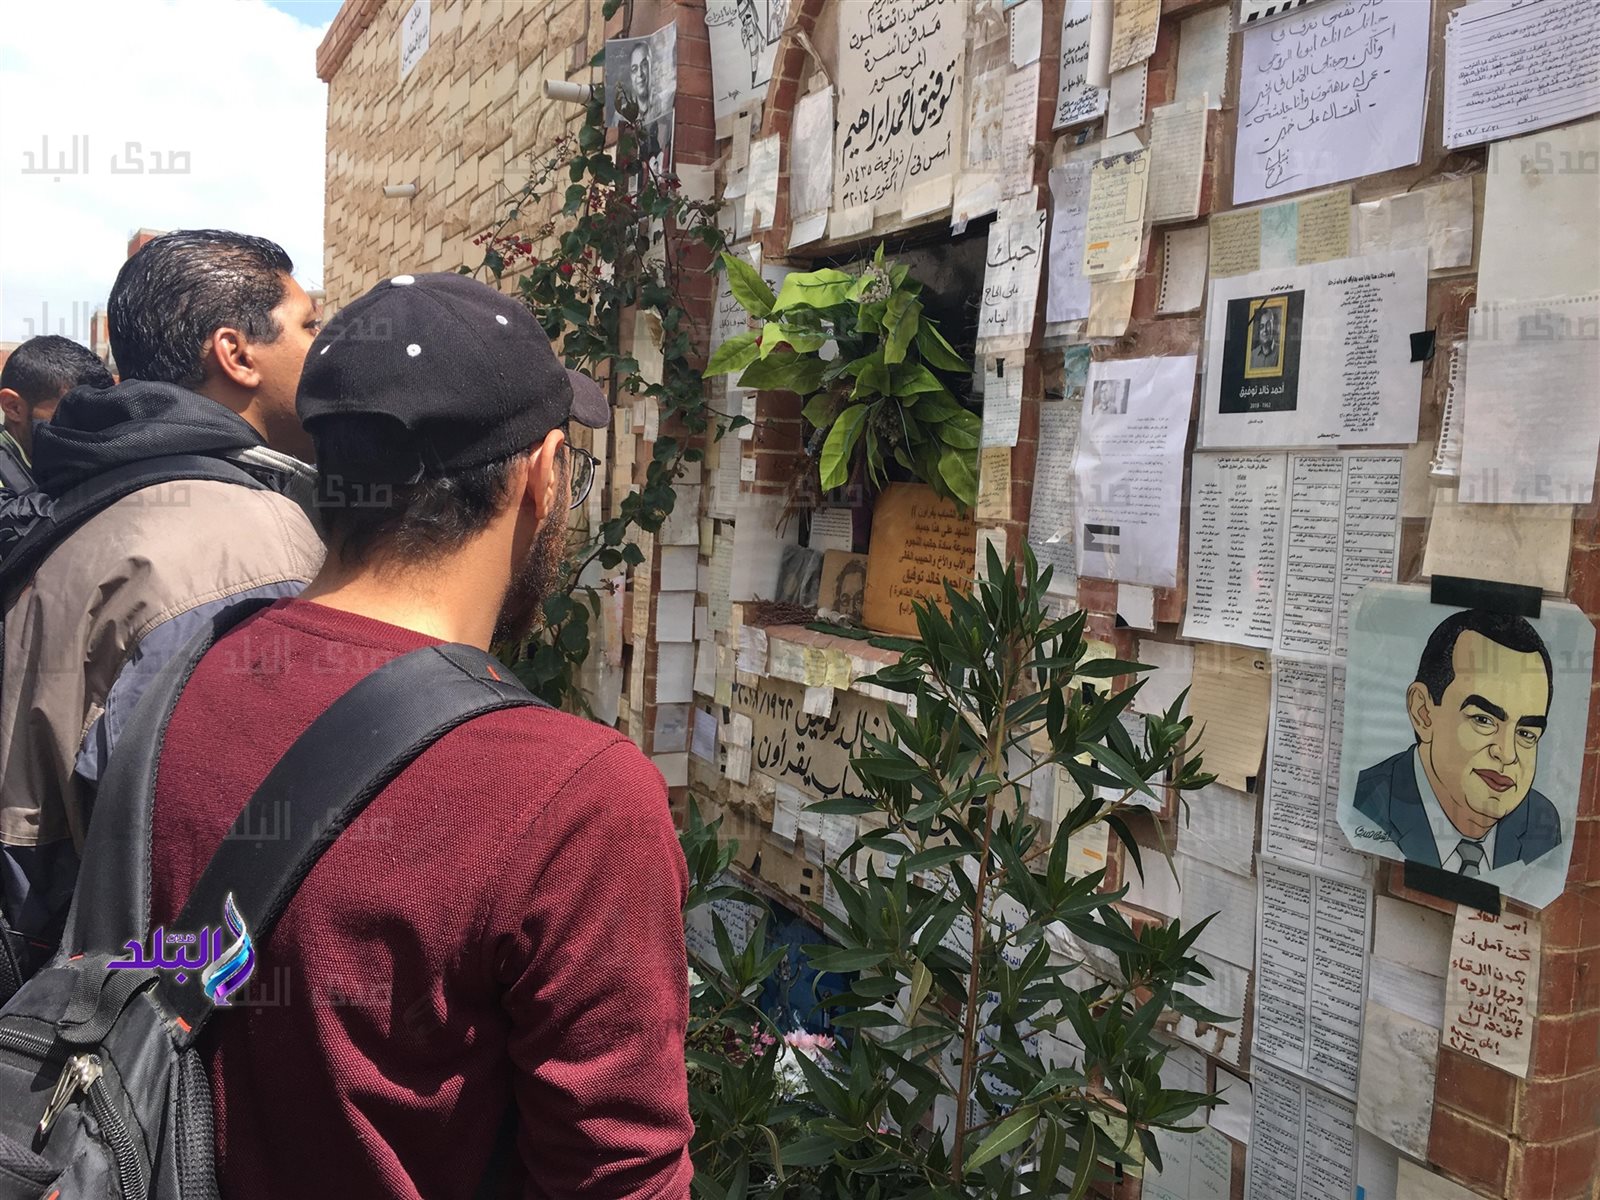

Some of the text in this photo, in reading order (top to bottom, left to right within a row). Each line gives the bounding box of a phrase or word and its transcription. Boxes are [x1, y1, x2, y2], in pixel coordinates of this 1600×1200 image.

[849, 22, 877, 50] الموت
[868, 46, 927, 96] المرحوم
[882, 76, 916, 148] أحمد
[911, 59, 957, 136] توفيق
[986, 211, 1047, 269] أحبك
[1239, 381, 1286, 398] أحمد خالد توفيق
[902, 565, 924, 585] توفيق
[925, 569, 942, 586] خالد
